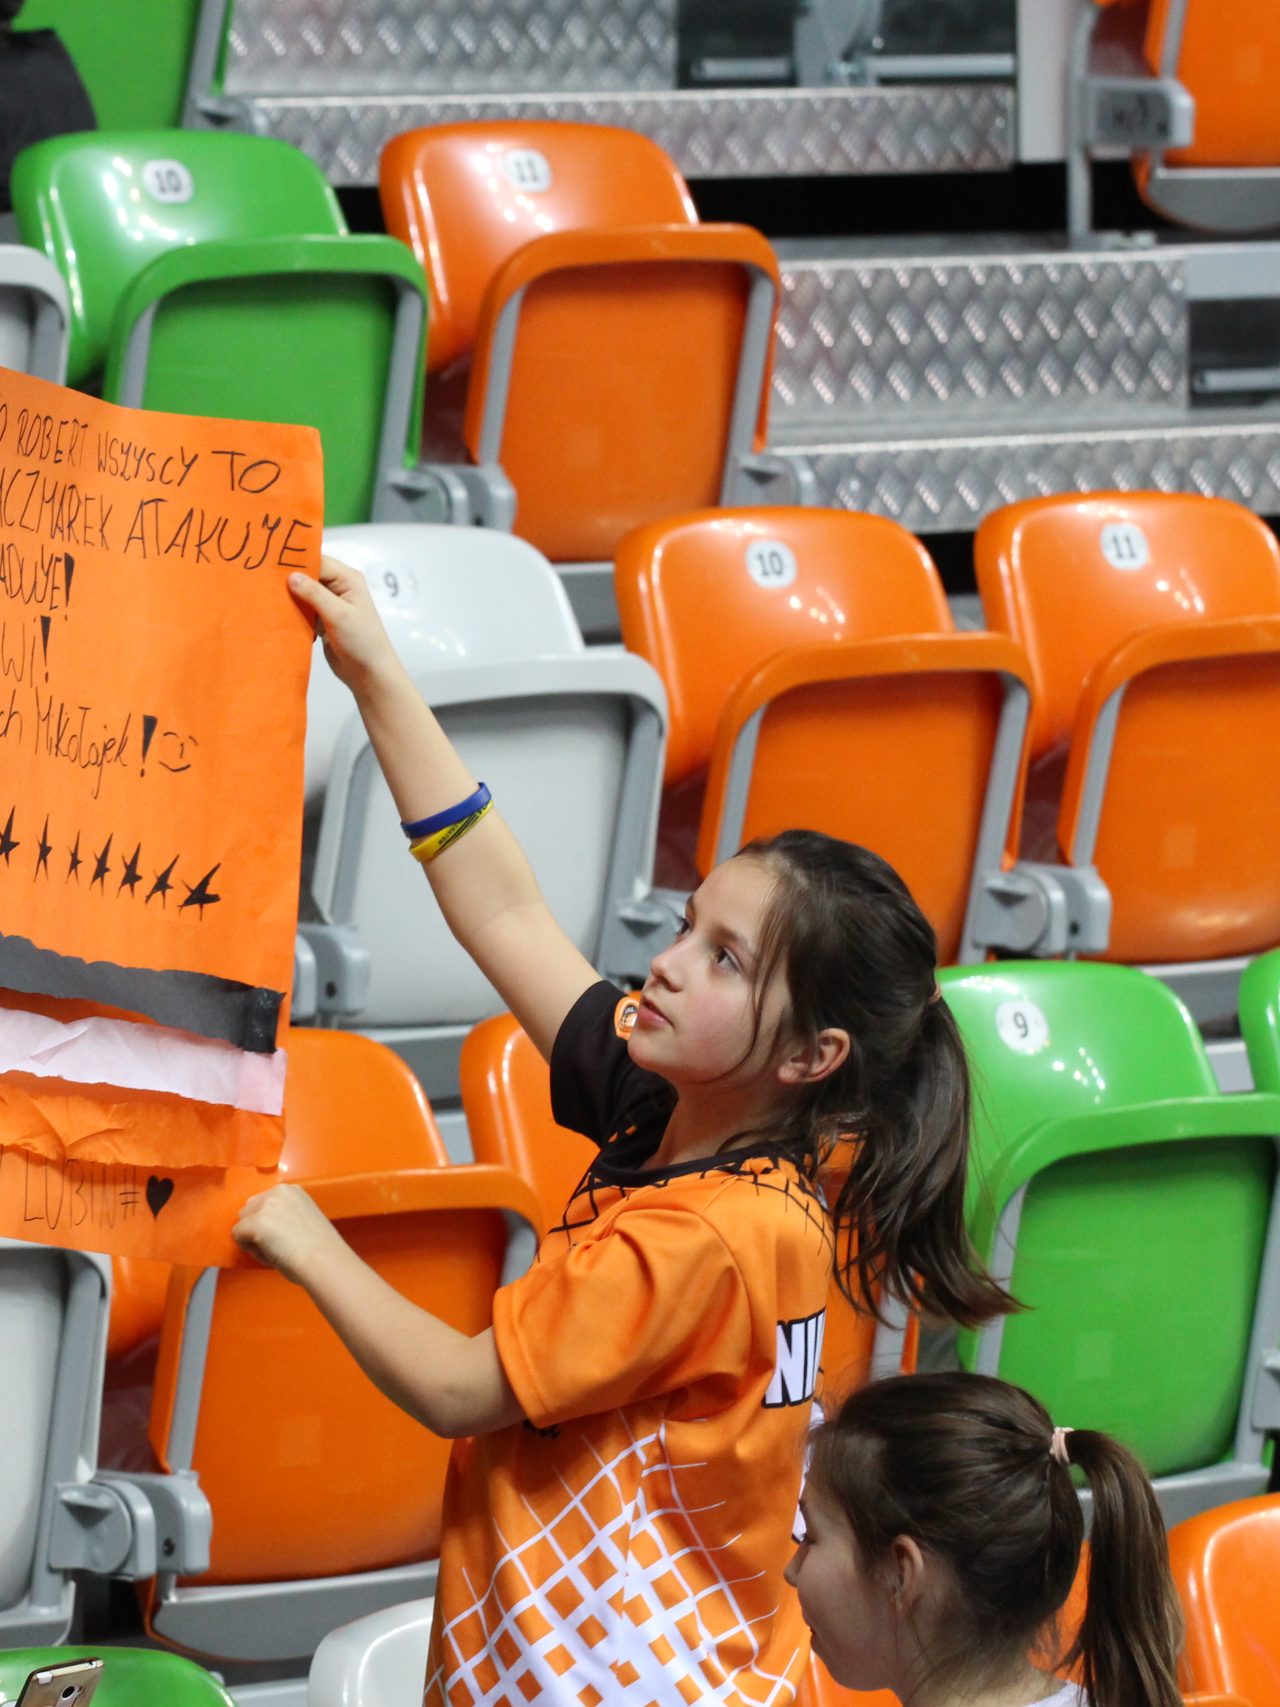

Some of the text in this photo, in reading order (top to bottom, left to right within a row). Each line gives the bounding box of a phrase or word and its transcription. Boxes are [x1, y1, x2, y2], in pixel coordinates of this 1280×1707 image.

[156, 171, 181, 194] 10
[515, 160, 539, 182] 11
[17, 409, 88, 467] ROBERT
[97, 431, 199, 487] WSZYSCY
[211, 450, 281, 493] TO
[123, 498, 312, 570] ATAKUJE
[1113, 534, 1136, 559] 11
[757, 551, 784, 577] 10
[384, 572, 399, 597] 9
[1013, 1012, 1029, 1038] 9
